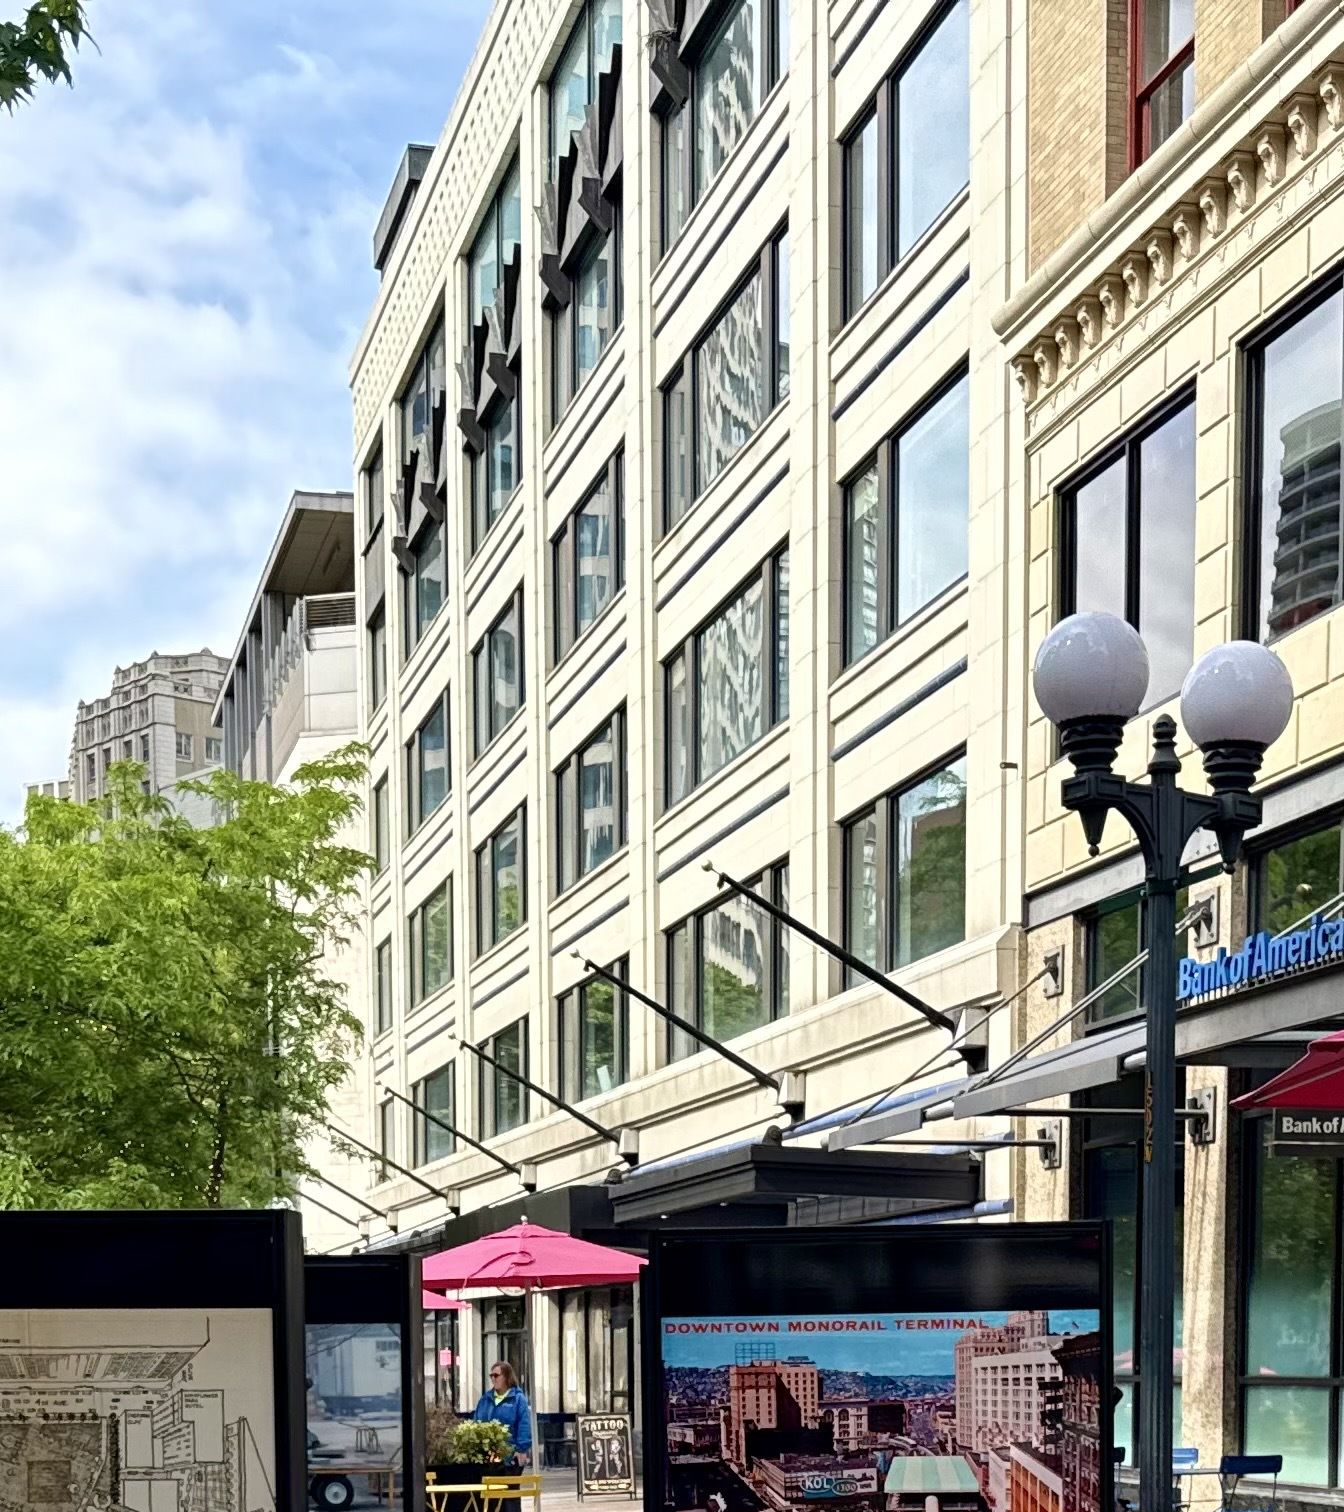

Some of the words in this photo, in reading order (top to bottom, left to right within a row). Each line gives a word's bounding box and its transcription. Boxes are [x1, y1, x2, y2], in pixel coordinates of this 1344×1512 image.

[1177, 947, 1232, 1001] Bank
[1231, 934, 1256, 985] of
[1282, 1117, 1321, 1133] Bank
[1323, 1117, 1340, 1134] of
[665, 1321, 780, 1334] DOWNTOWN
[787, 1319, 888, 1332] MONORAIL
[894, 1317, 990, 1331] TERMINAL
[584, 1420, 624, 1431] TATTOO
[805, 1477, 831, 1489] KOL
